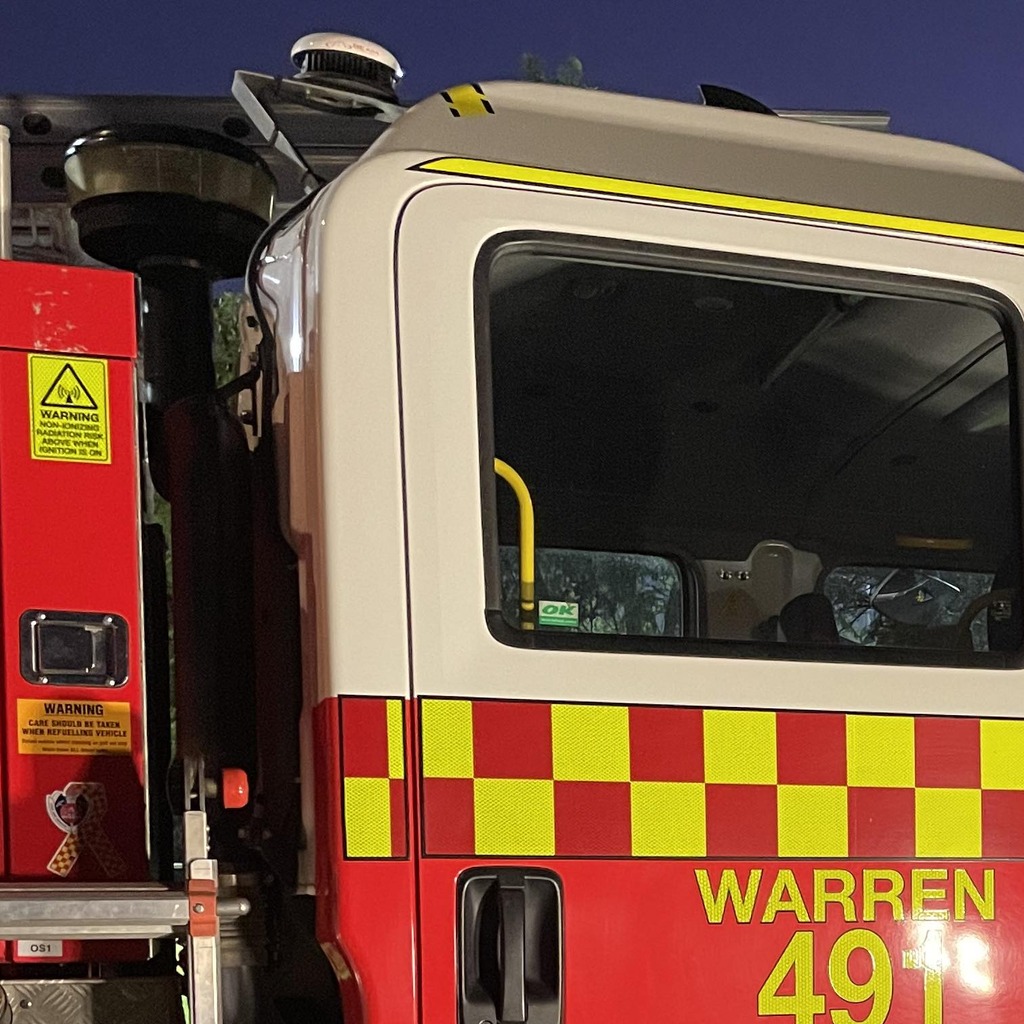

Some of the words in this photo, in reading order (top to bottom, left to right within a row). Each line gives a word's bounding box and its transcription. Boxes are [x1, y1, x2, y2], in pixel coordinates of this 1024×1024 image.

[41, 410, 99, 422] WARNING
[37, 429, 82, 438] RADIATION
[84, 432, 103, 440] RISK
[42, 438, 71, 447] ABOVE
[40, 446, 76, 455] IGNITION
[542, 604, 576, 616] OK
[44, 703, 104, 716] WARNING
[29, 719, 48, 727] CARE
[52, 720, 82, 728] SHOULD
[84, 720, 94, 728] BE
[47, 728, 93, 736] REFUELLING
[96, 729, 127, 738] VEHICLE
[694, 868, 996, 925] WARREN
[31, 944, 51, 953] OS1
